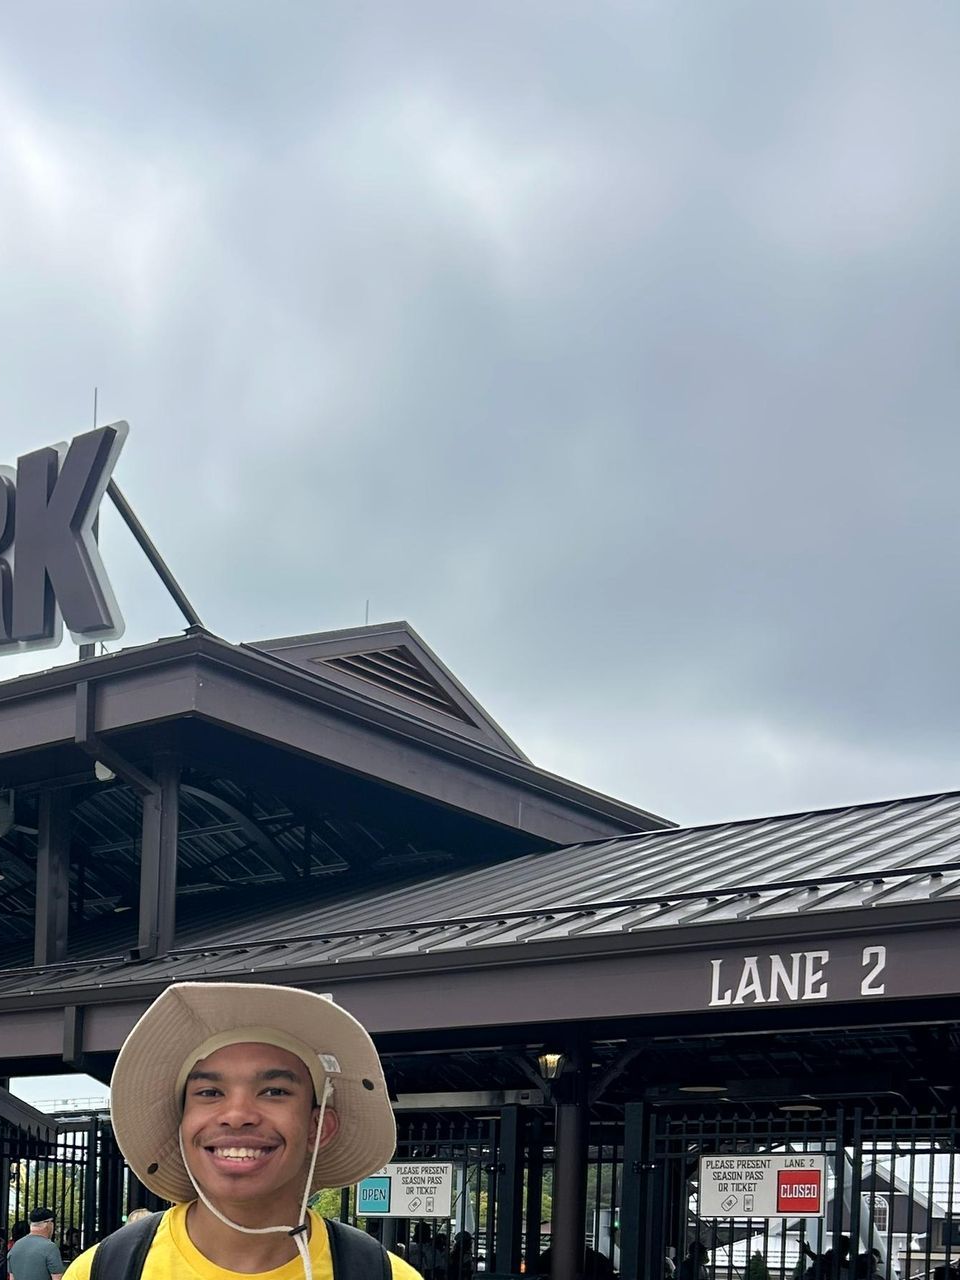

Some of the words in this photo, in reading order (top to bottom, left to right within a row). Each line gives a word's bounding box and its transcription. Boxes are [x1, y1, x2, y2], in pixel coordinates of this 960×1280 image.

[708, 951, 829, 1007] LANE
[861, 946, 886, 995] 2
[706, 1160, 735, 1169] PLEASE
[737, 1160, 771, 1169] PRESENT
[784, 1159, 805, 1168] LANE
[809, 1159, 815, 1168] 2
[396, 1166, 419, 1175] PLEASE
[420, 1166, 448, 1175] PRESENT
[402, 1176, 426, 1185] SEASON
[427, 1176, 443, 1185] PASS
[712, 1171, 743, 1181] SEASON
[745, 1171, 764, 1181] PASS
[405, 1186, 414, 1195] OR
[416, 1186, 437, 1195] TICKET
[718, 1183, 728, 1192] OR
[731, 1183, 757, 1192] TICKET
[780, 1184, 818, 1198] CLOSED
[362, 1188, 386, 1201] OPEN
